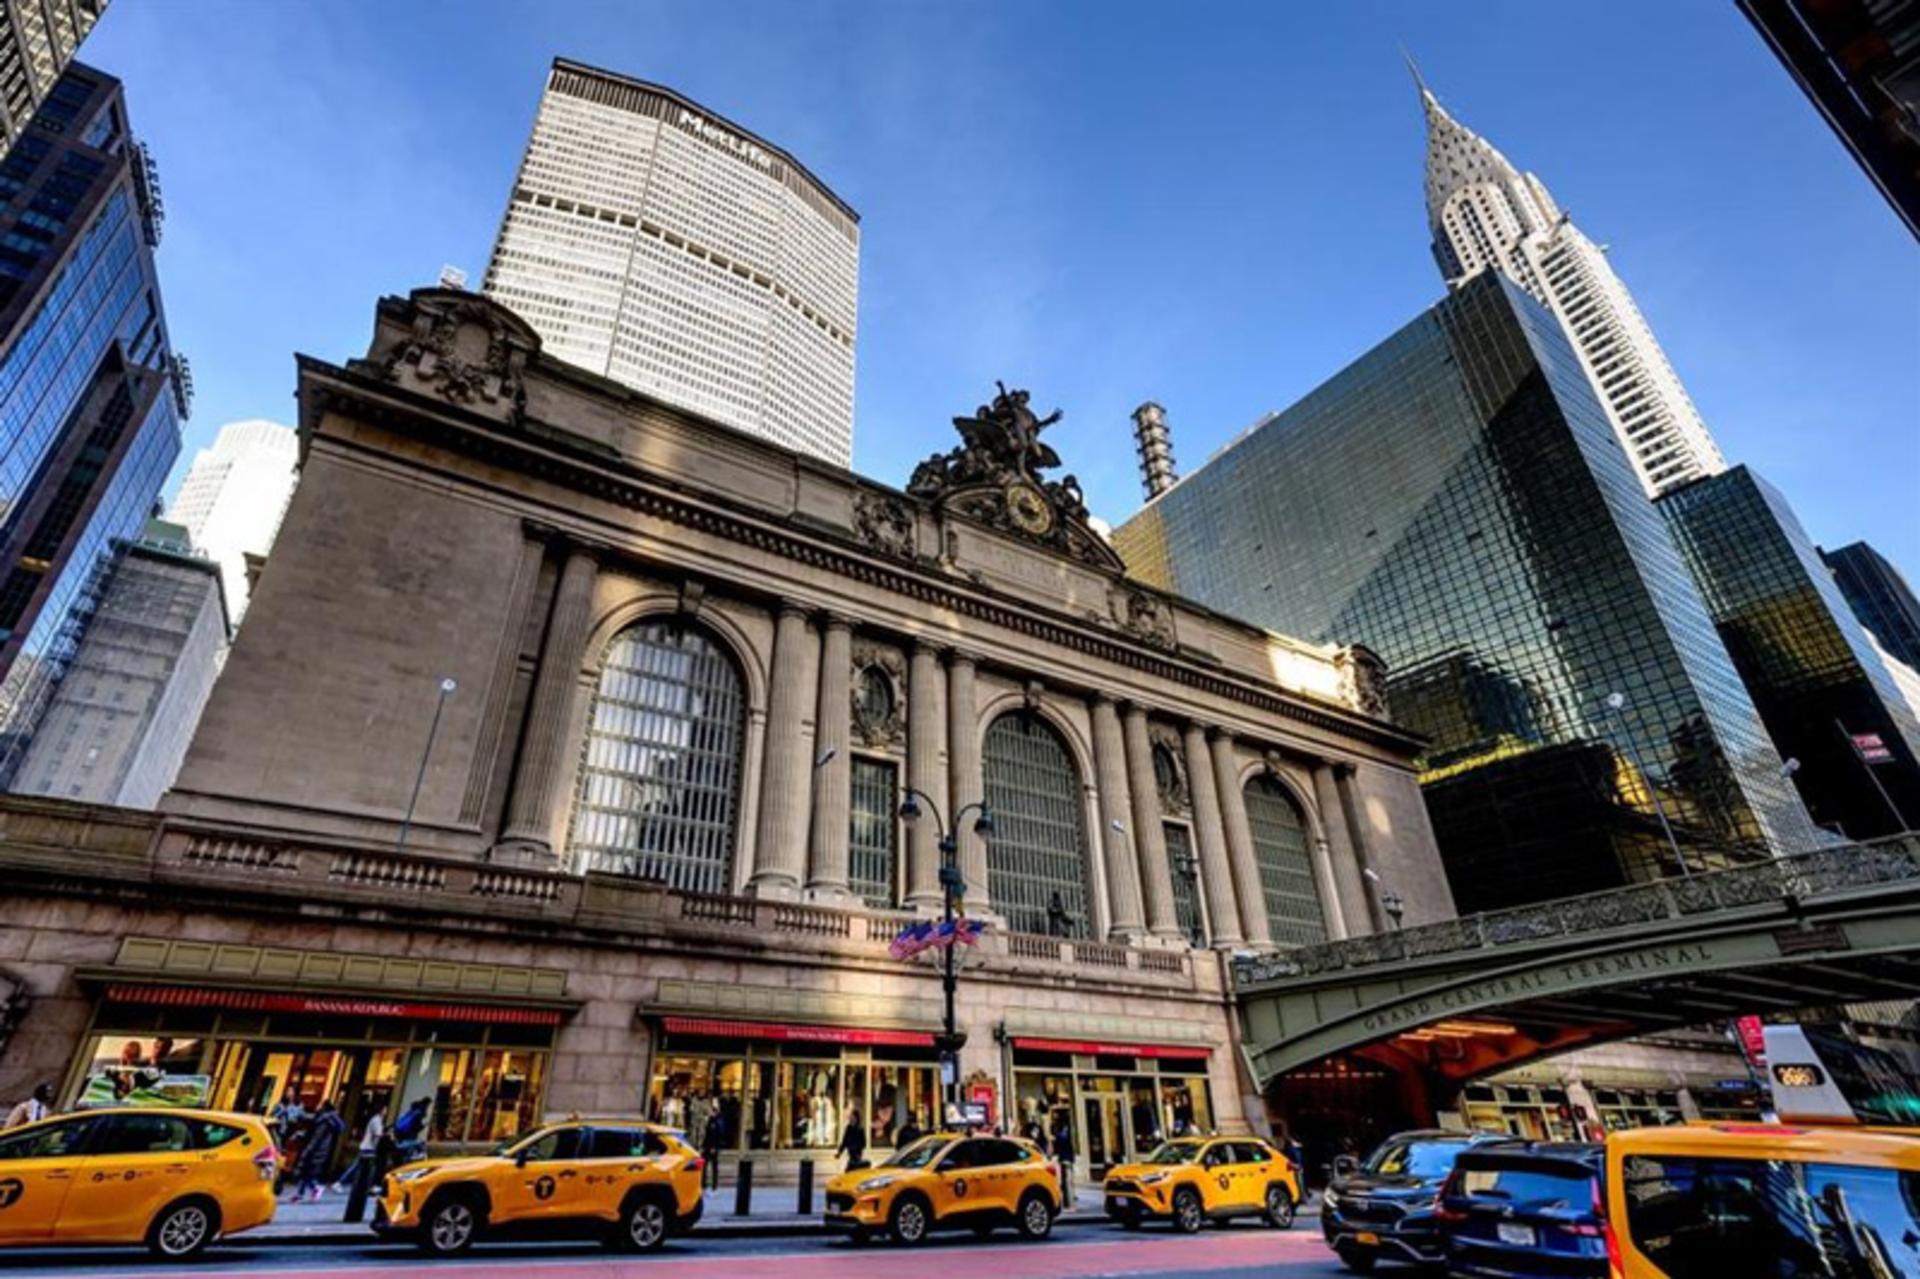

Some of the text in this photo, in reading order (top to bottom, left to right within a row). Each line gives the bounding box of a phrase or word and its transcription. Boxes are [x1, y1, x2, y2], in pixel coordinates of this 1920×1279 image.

[1363, 945, 1712, 1031] GRAND CENTRAL TERMINAL
